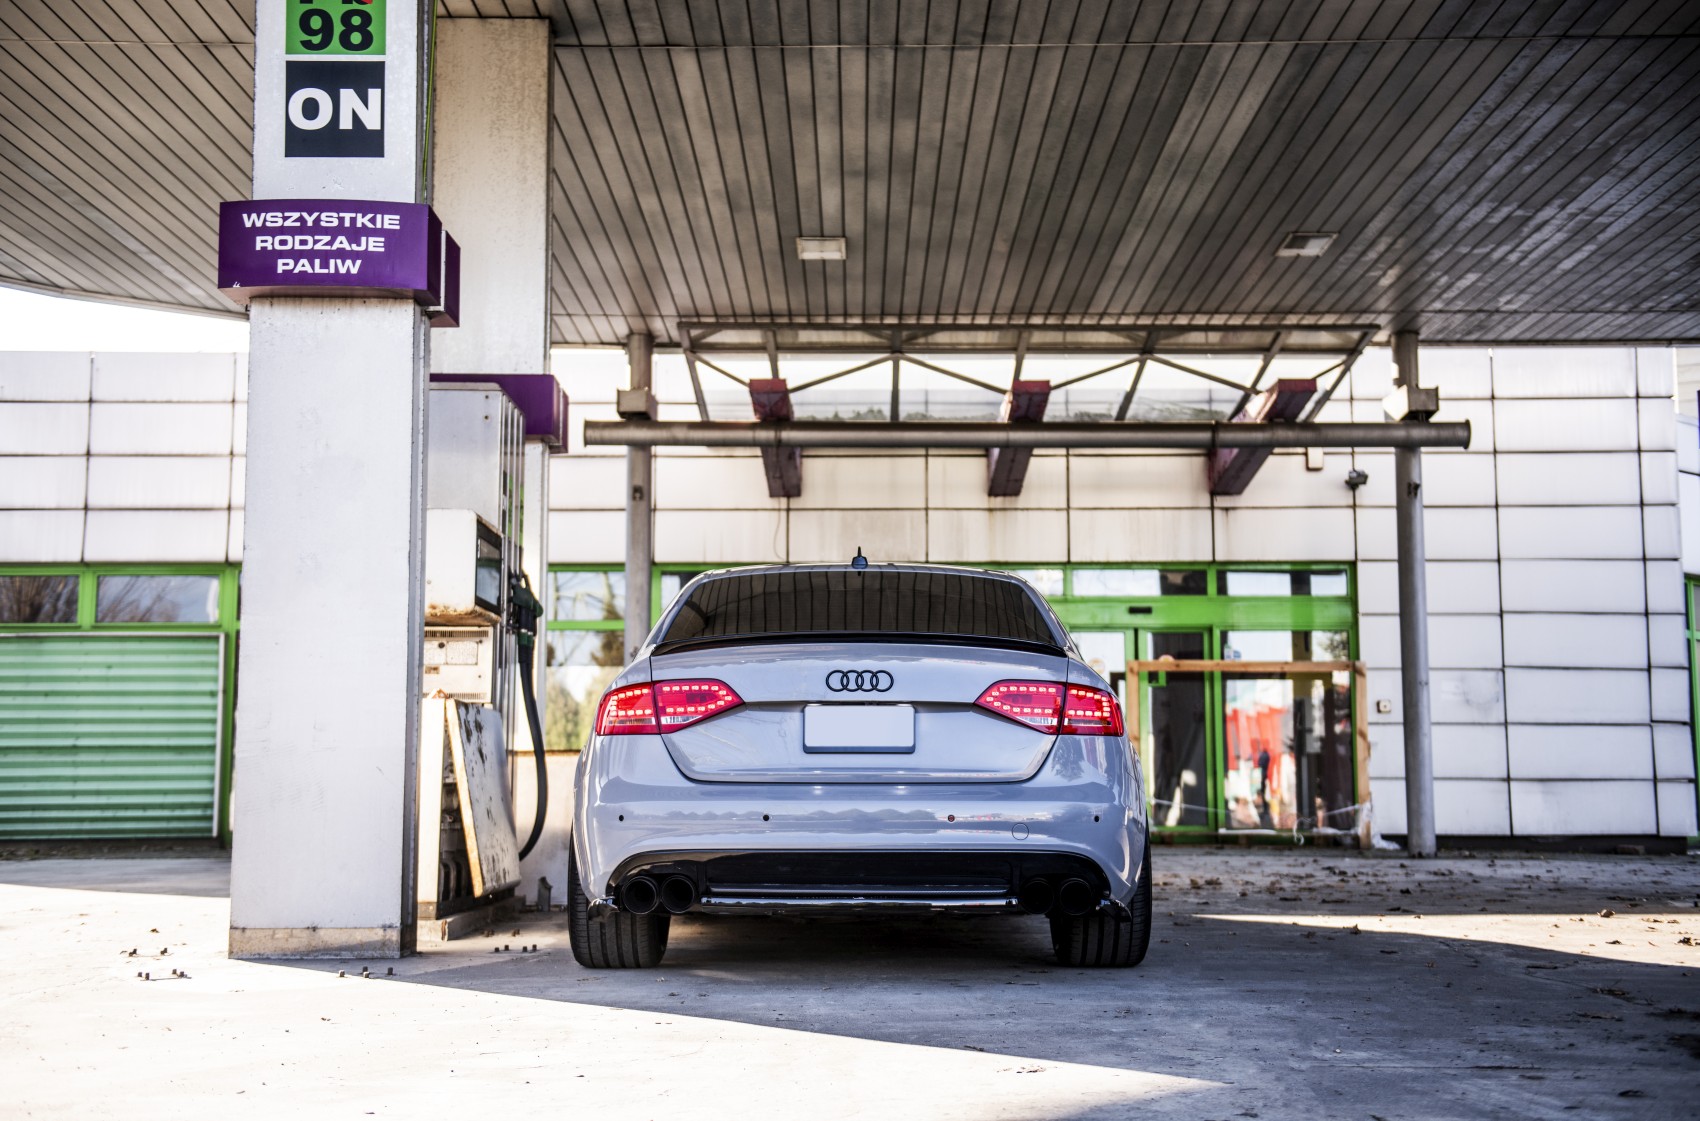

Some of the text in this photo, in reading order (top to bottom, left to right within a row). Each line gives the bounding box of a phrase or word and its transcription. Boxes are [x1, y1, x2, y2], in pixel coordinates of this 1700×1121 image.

[299, 8, 374, 51] 98
[288, 87, 382, 130] ON
[242, 211, 401, 230] WSZYSTKIE
[255, 235, 385, 252] RODZAJE
[277, 258, 362, 274] PALIW
